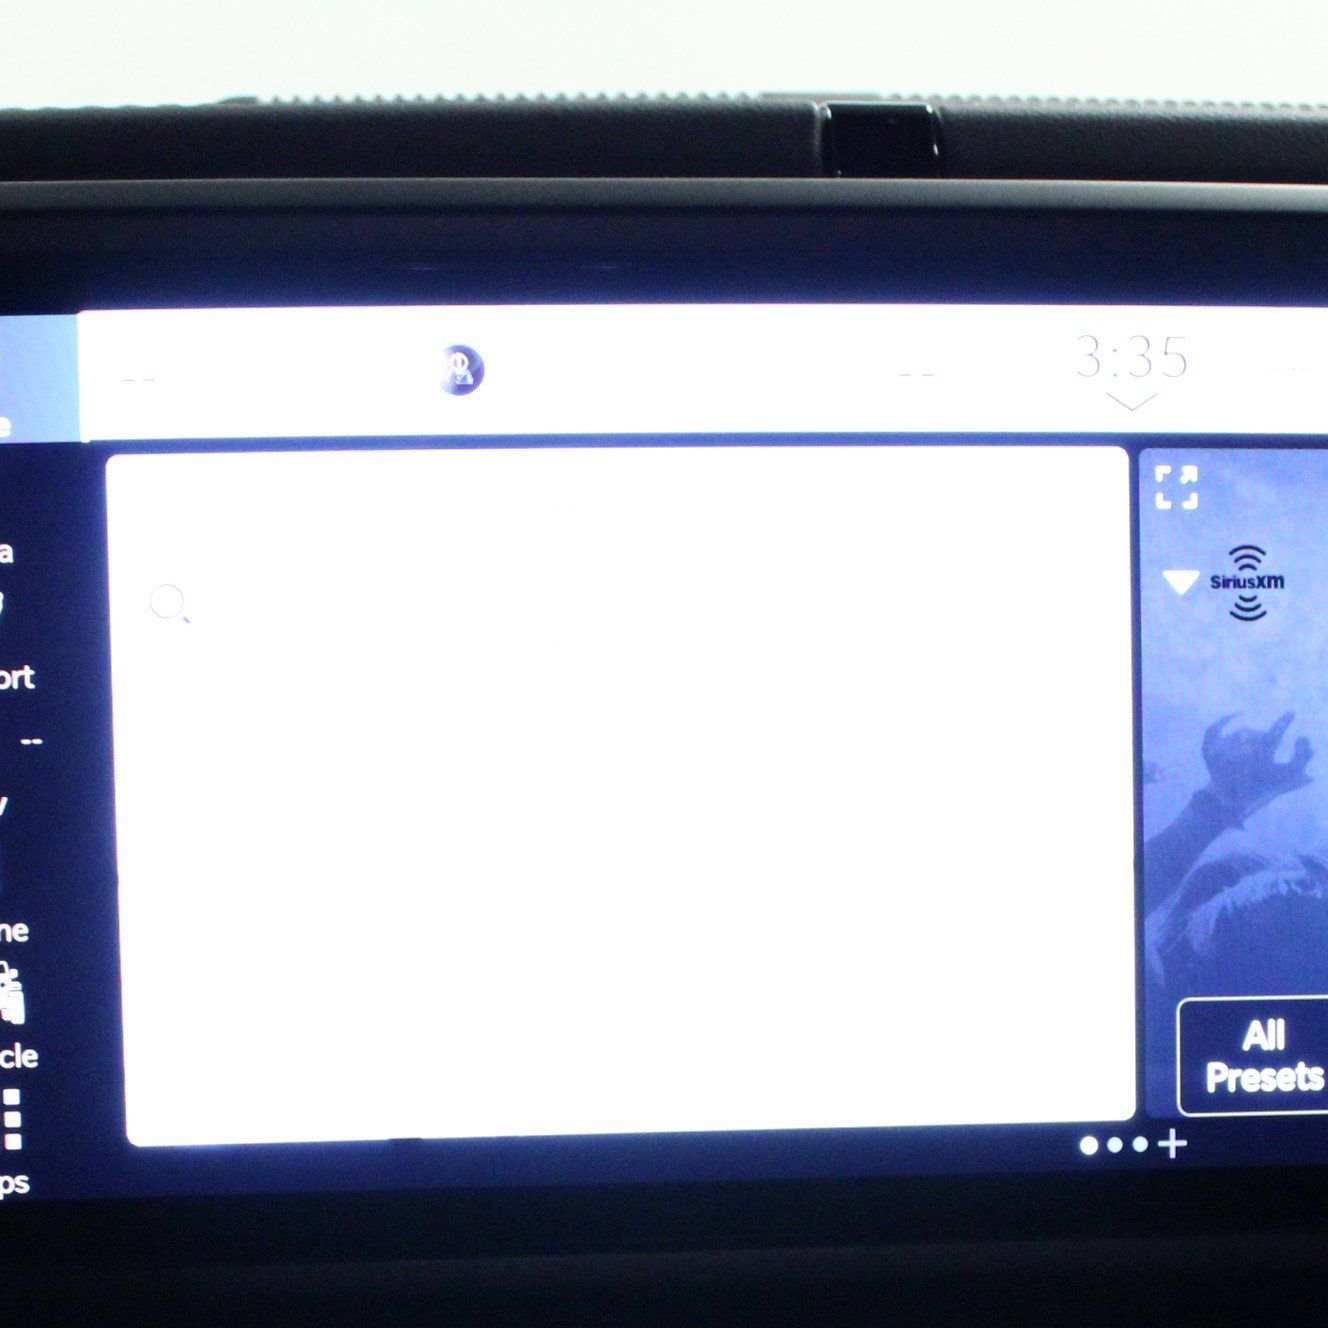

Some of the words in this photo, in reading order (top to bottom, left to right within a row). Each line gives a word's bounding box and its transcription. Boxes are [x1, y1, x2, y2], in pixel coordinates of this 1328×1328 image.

[1075, 333, 1191, 380] 3:35
[1210, 574, 1285, 590] SiriusXM
[1242, 1018, 1285, 1051] All
[1206, 1061, 1326, 1093] Presets
